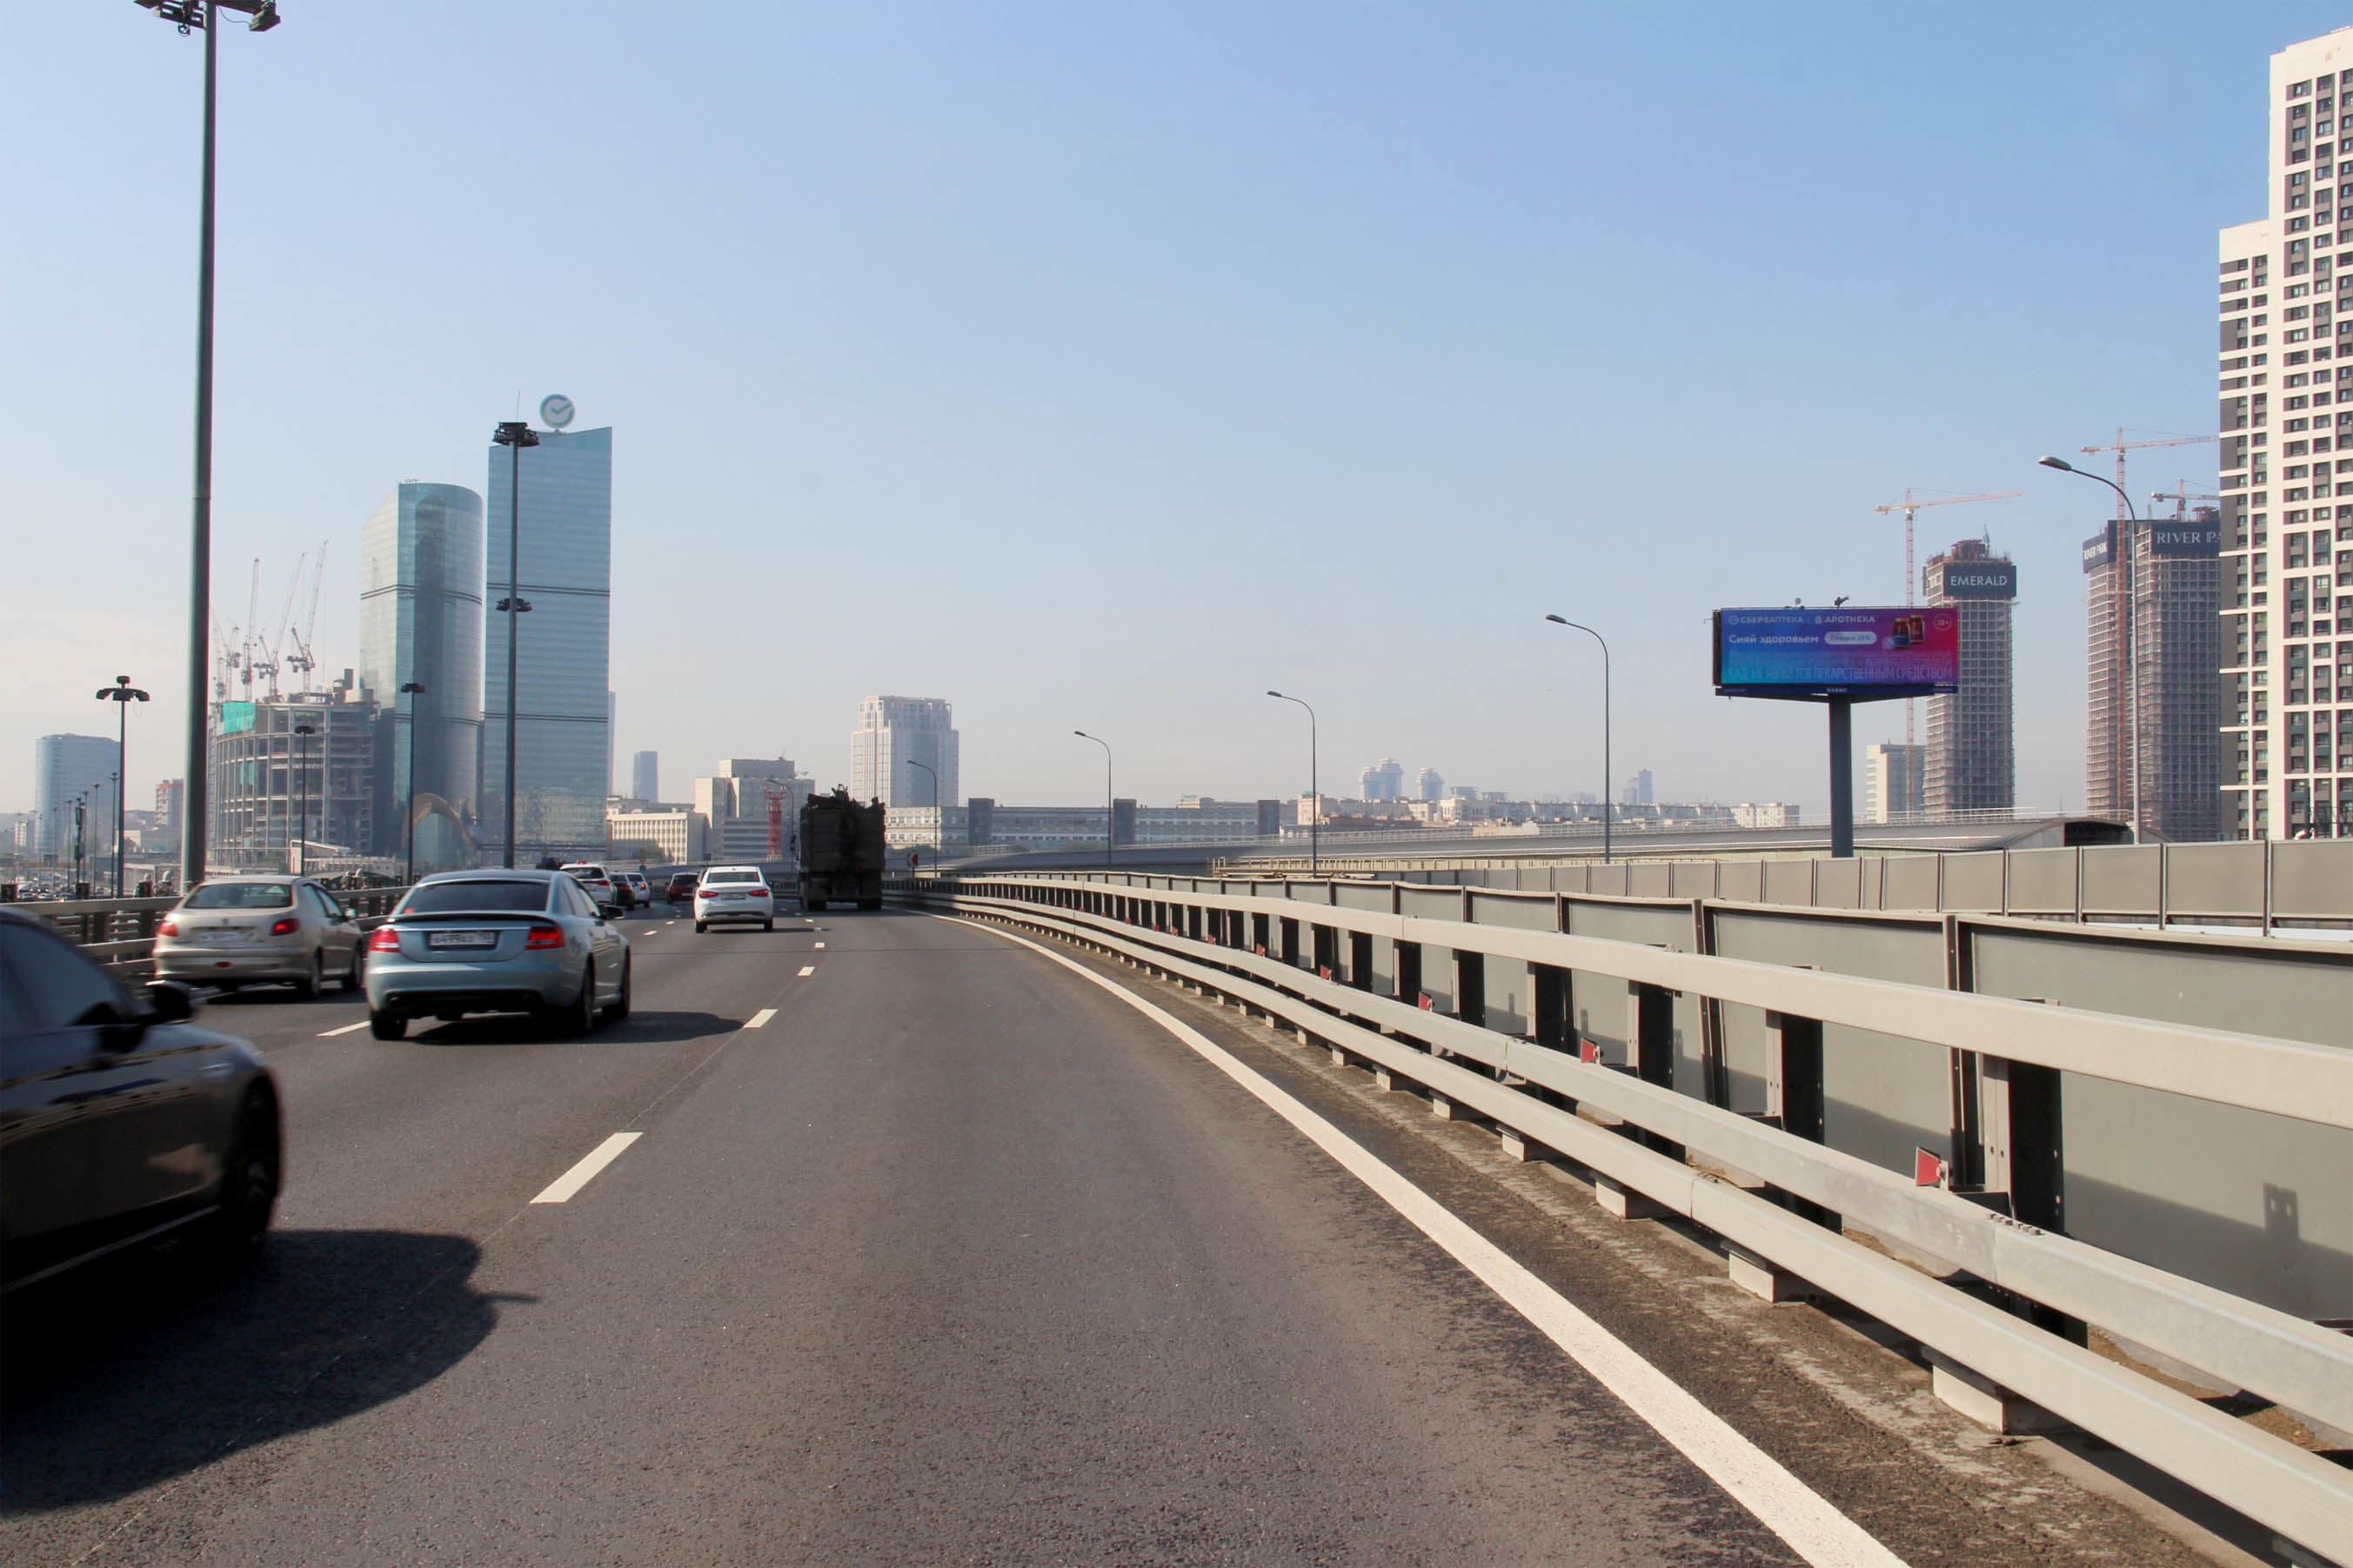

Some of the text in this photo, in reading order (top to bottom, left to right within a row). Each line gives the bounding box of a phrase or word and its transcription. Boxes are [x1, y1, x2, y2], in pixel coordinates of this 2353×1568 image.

[2156, 530, 2222, 544] RIVER PA
[1950, 575, 2009, 586] EMERALD
[1728, 633, 1819, 645] Сияй здоровьем
